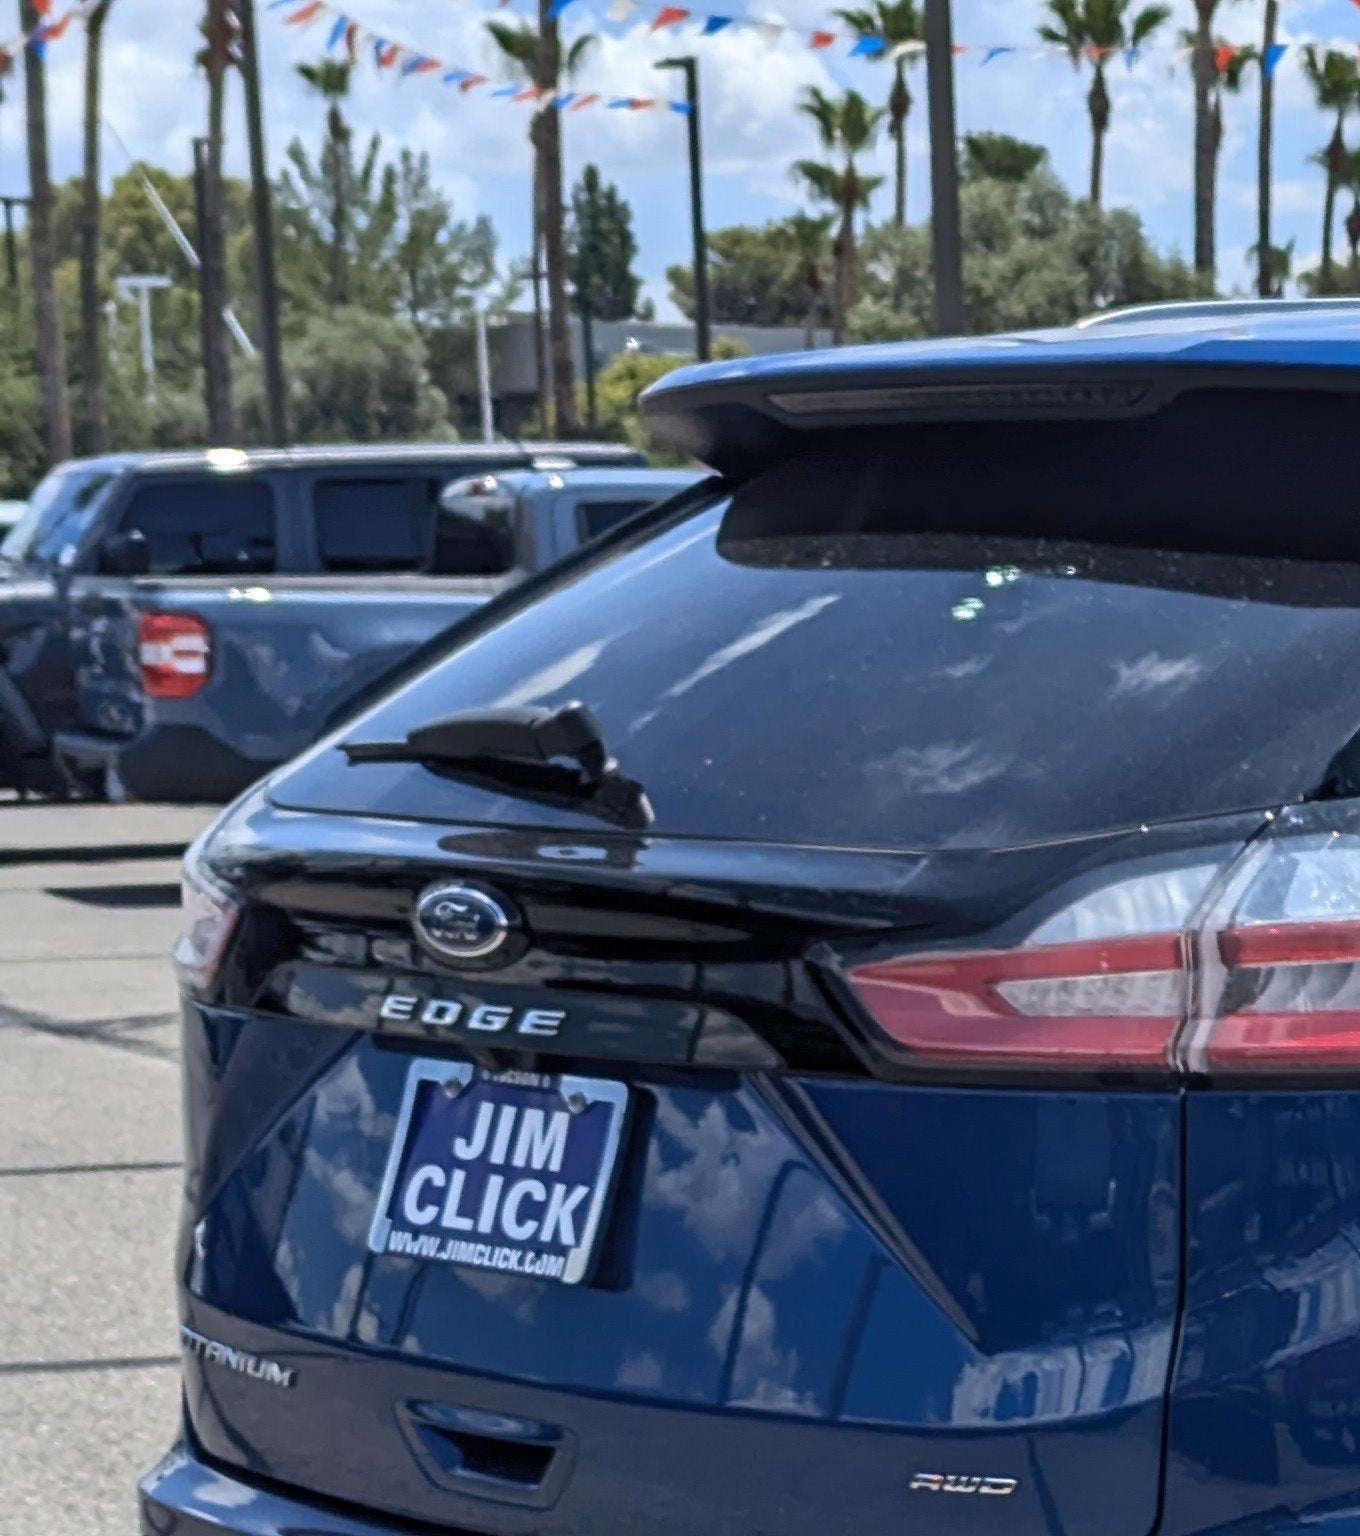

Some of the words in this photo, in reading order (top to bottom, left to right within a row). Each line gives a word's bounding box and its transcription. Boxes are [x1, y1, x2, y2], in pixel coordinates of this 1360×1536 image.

[432, 900, 481, 941] Ford
[380, 994, 566, 1037] EDGE
[453, 1100, 570, 1172] JIM
[403, 1164, 590, 1246] CLICK
[388, 1230, 566, 1278] WWW.JIMCLICK.COM
[909, 1473, 1018, 1495] AWD
